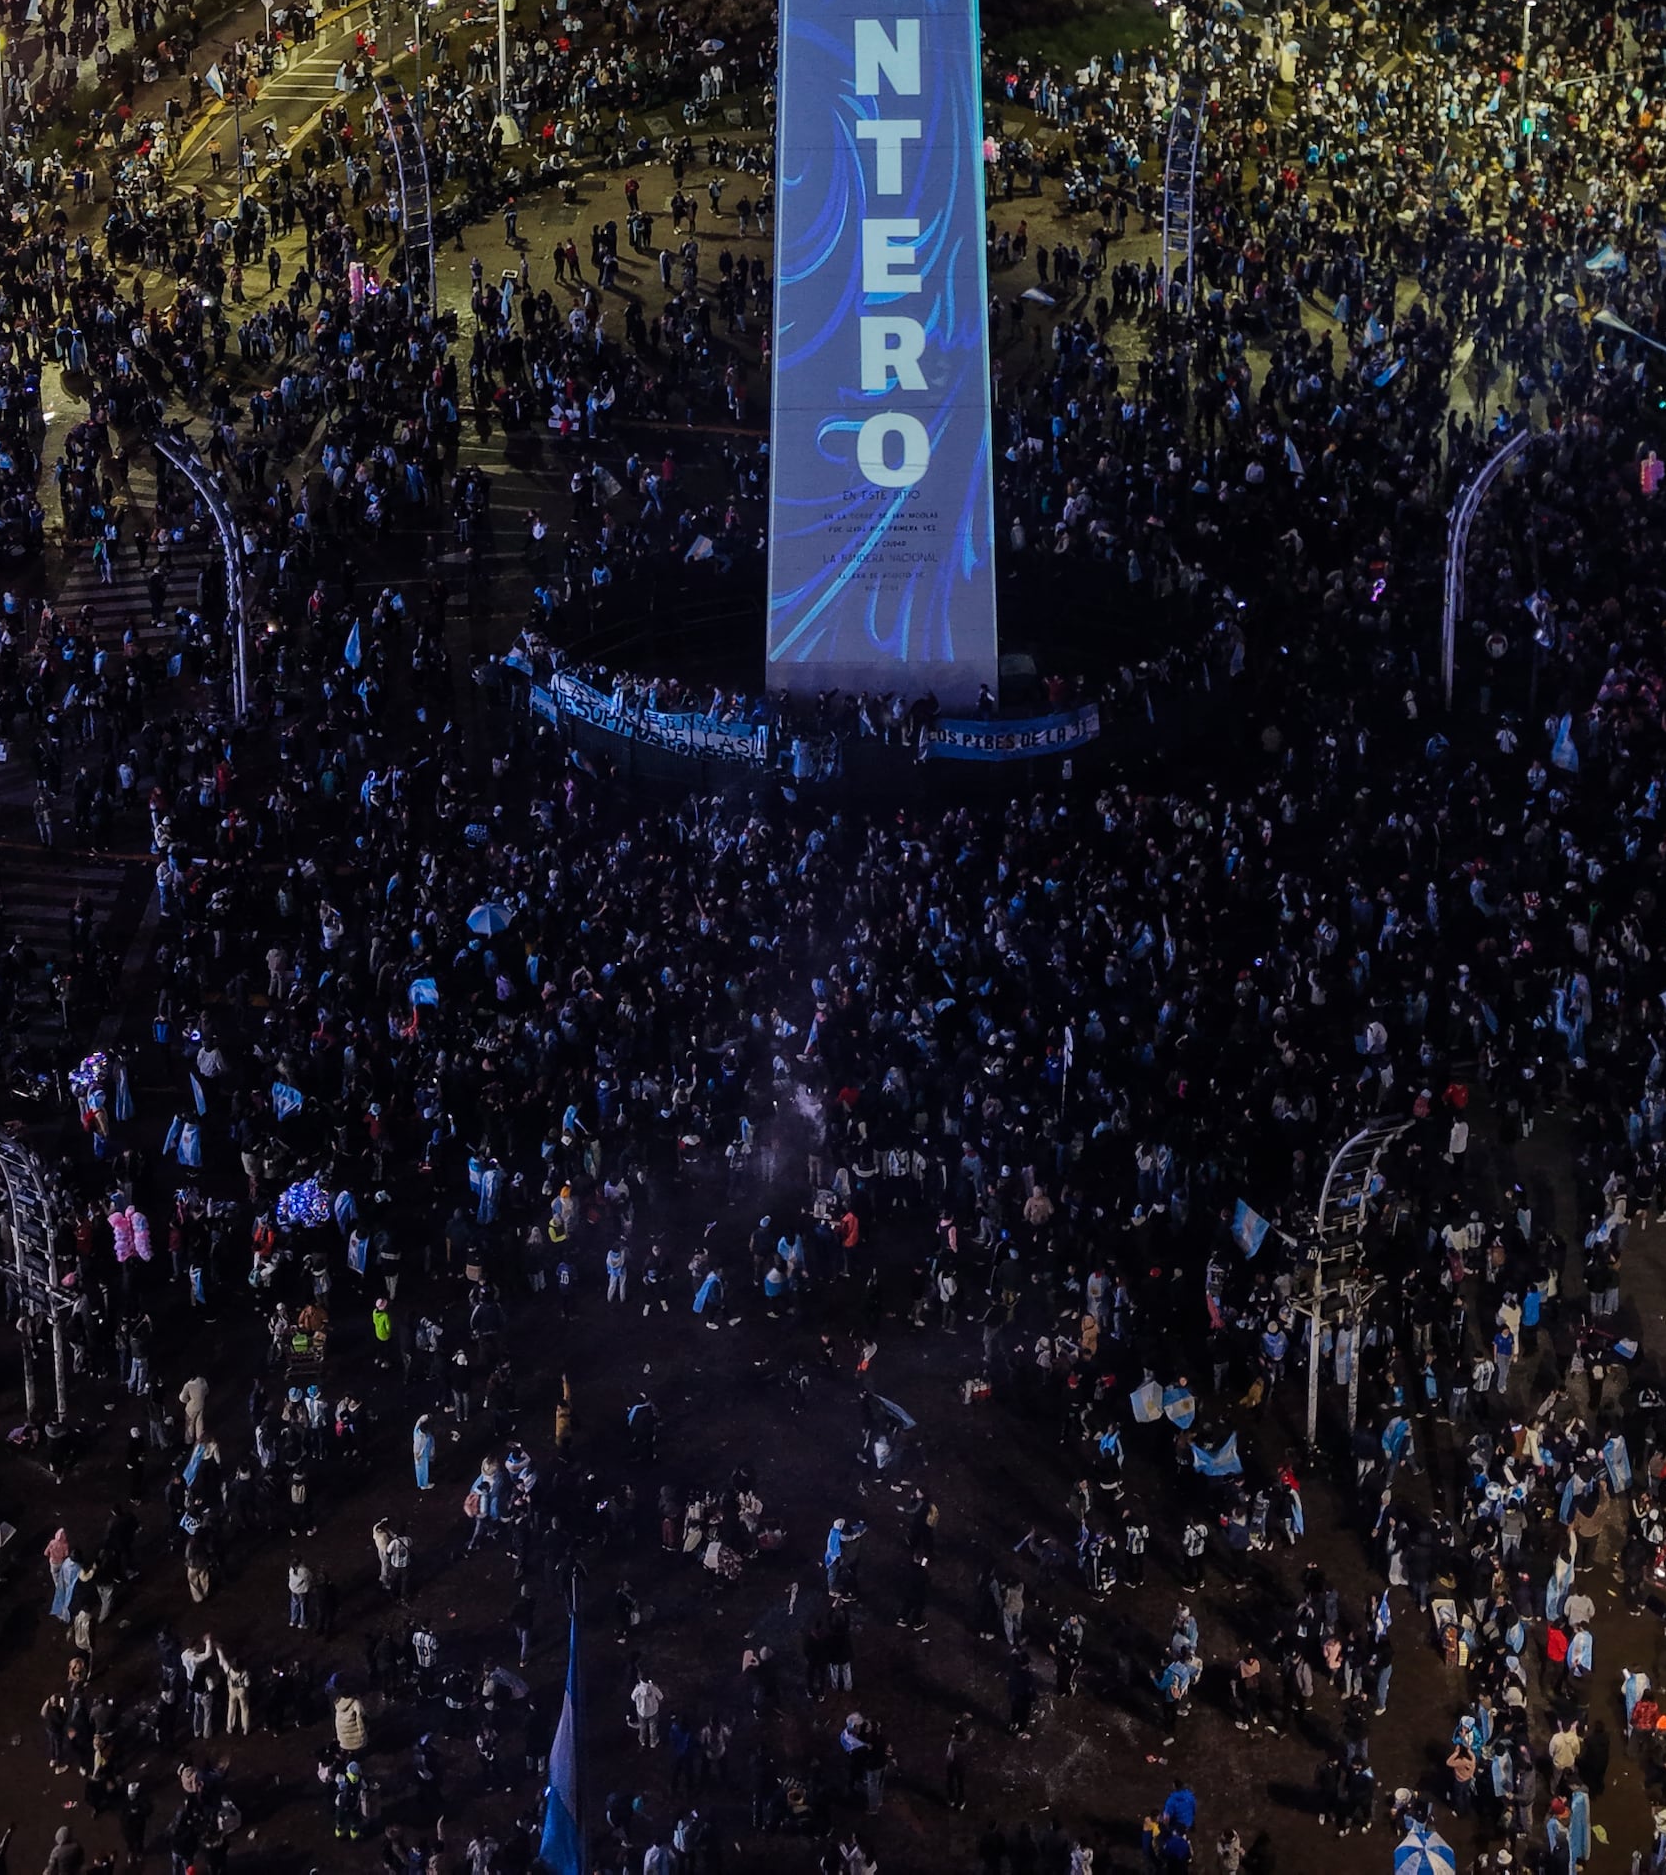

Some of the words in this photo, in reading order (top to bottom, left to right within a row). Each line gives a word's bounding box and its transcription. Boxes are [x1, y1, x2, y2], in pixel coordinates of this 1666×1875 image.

[843, 490, 856, 500] EN
[862, 490, 887, 500] ESTE
[963, 733, 1016, 750] PIBES
[1021, 732, 1041, 748] DE
[1047, 727, 1066, 744] LA
